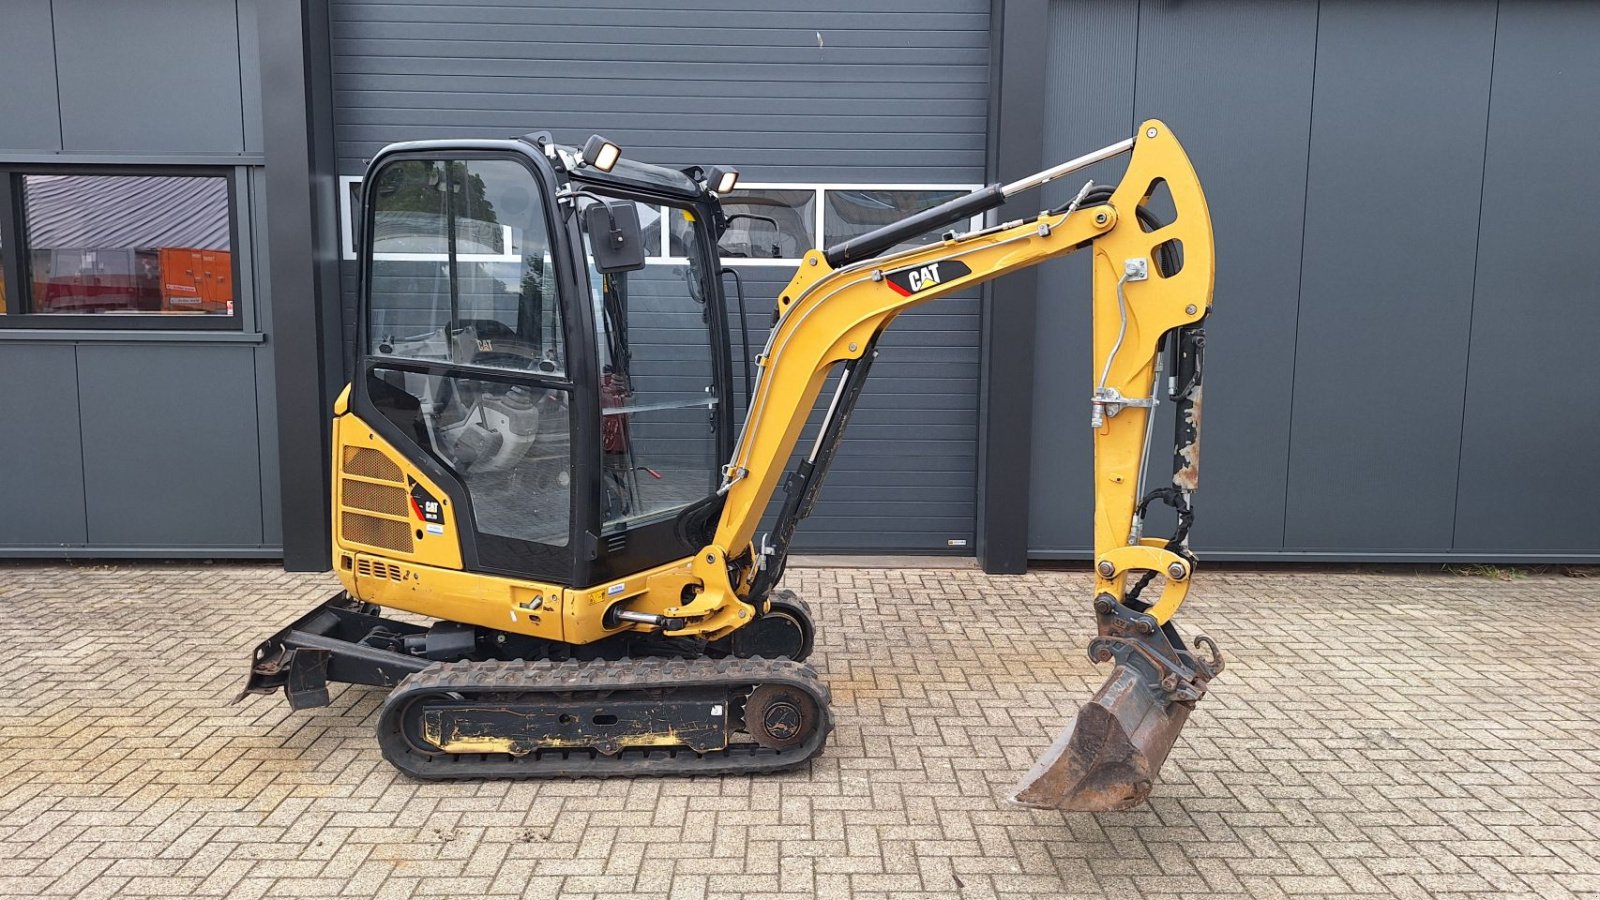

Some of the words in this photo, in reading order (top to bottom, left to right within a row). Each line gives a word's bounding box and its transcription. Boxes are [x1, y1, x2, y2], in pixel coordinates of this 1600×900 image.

[908, 263, 940, 291] CAT
[477, 340, 493, 352] CAT
[426, 501, 438, 513] CAT
